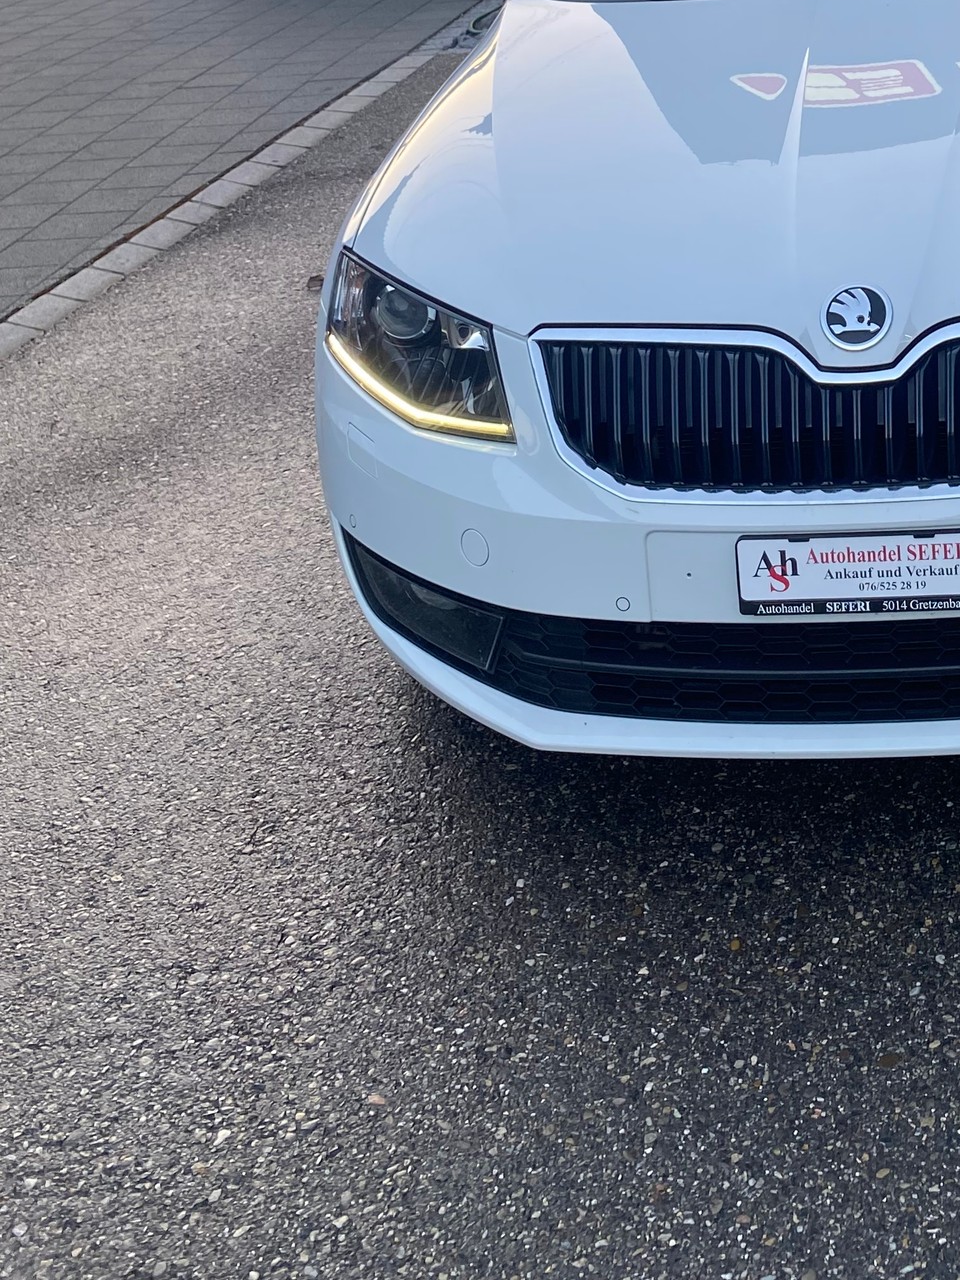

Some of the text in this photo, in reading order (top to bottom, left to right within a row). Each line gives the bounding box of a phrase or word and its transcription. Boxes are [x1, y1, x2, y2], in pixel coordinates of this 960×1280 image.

[806, 545, 901, 565] Autohandel
[824, 564, 960, 580] Ankauf und Verkauf
[858, 580, 927, 592] 076/525 28 19
[756, 602, 815, 615] Autohandel
[825, 600, 871, 612] SEFERI
[882, 600, 908, 611] 5014
